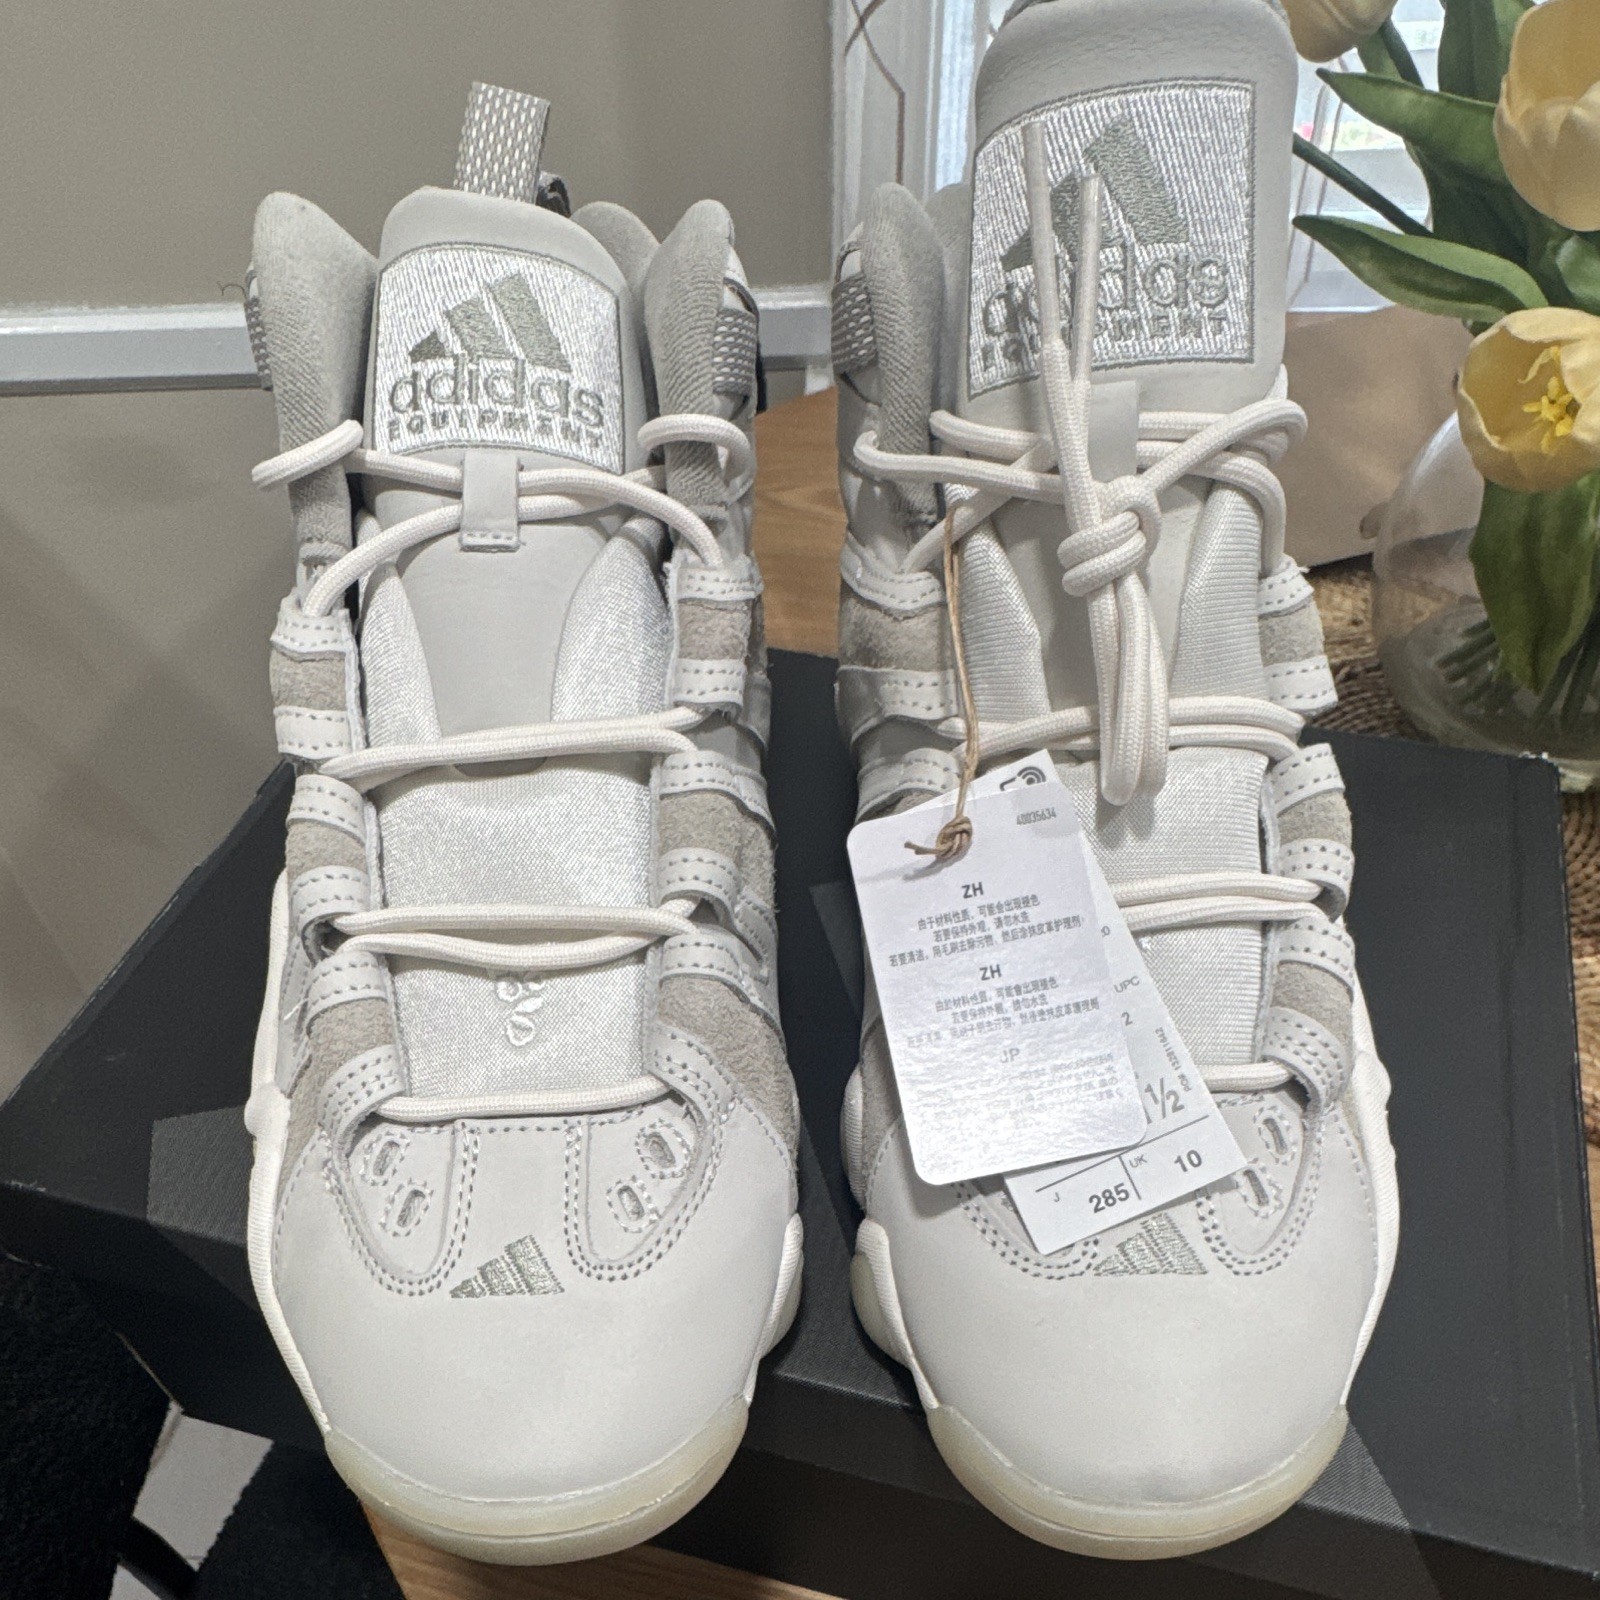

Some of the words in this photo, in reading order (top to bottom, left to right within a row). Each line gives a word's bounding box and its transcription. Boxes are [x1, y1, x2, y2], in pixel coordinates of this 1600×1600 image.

[389, 352, 604, 427] adidas
[387, 408, 603, 448] EQUIPMENT
[961, 881, 984, 899] ZH
[979, 964, 1002, 981] ZH
[1113, 975, 1140, 994] UPC
[1001, 1048, 1020, 1064] JP
[1129, 1153, 1148, 1169] UK
[1174, 1149, 1203, 1173] 10
[1053, 1192, 1060, 1203] J
[1088, 1182, 1130, 1214] 285
